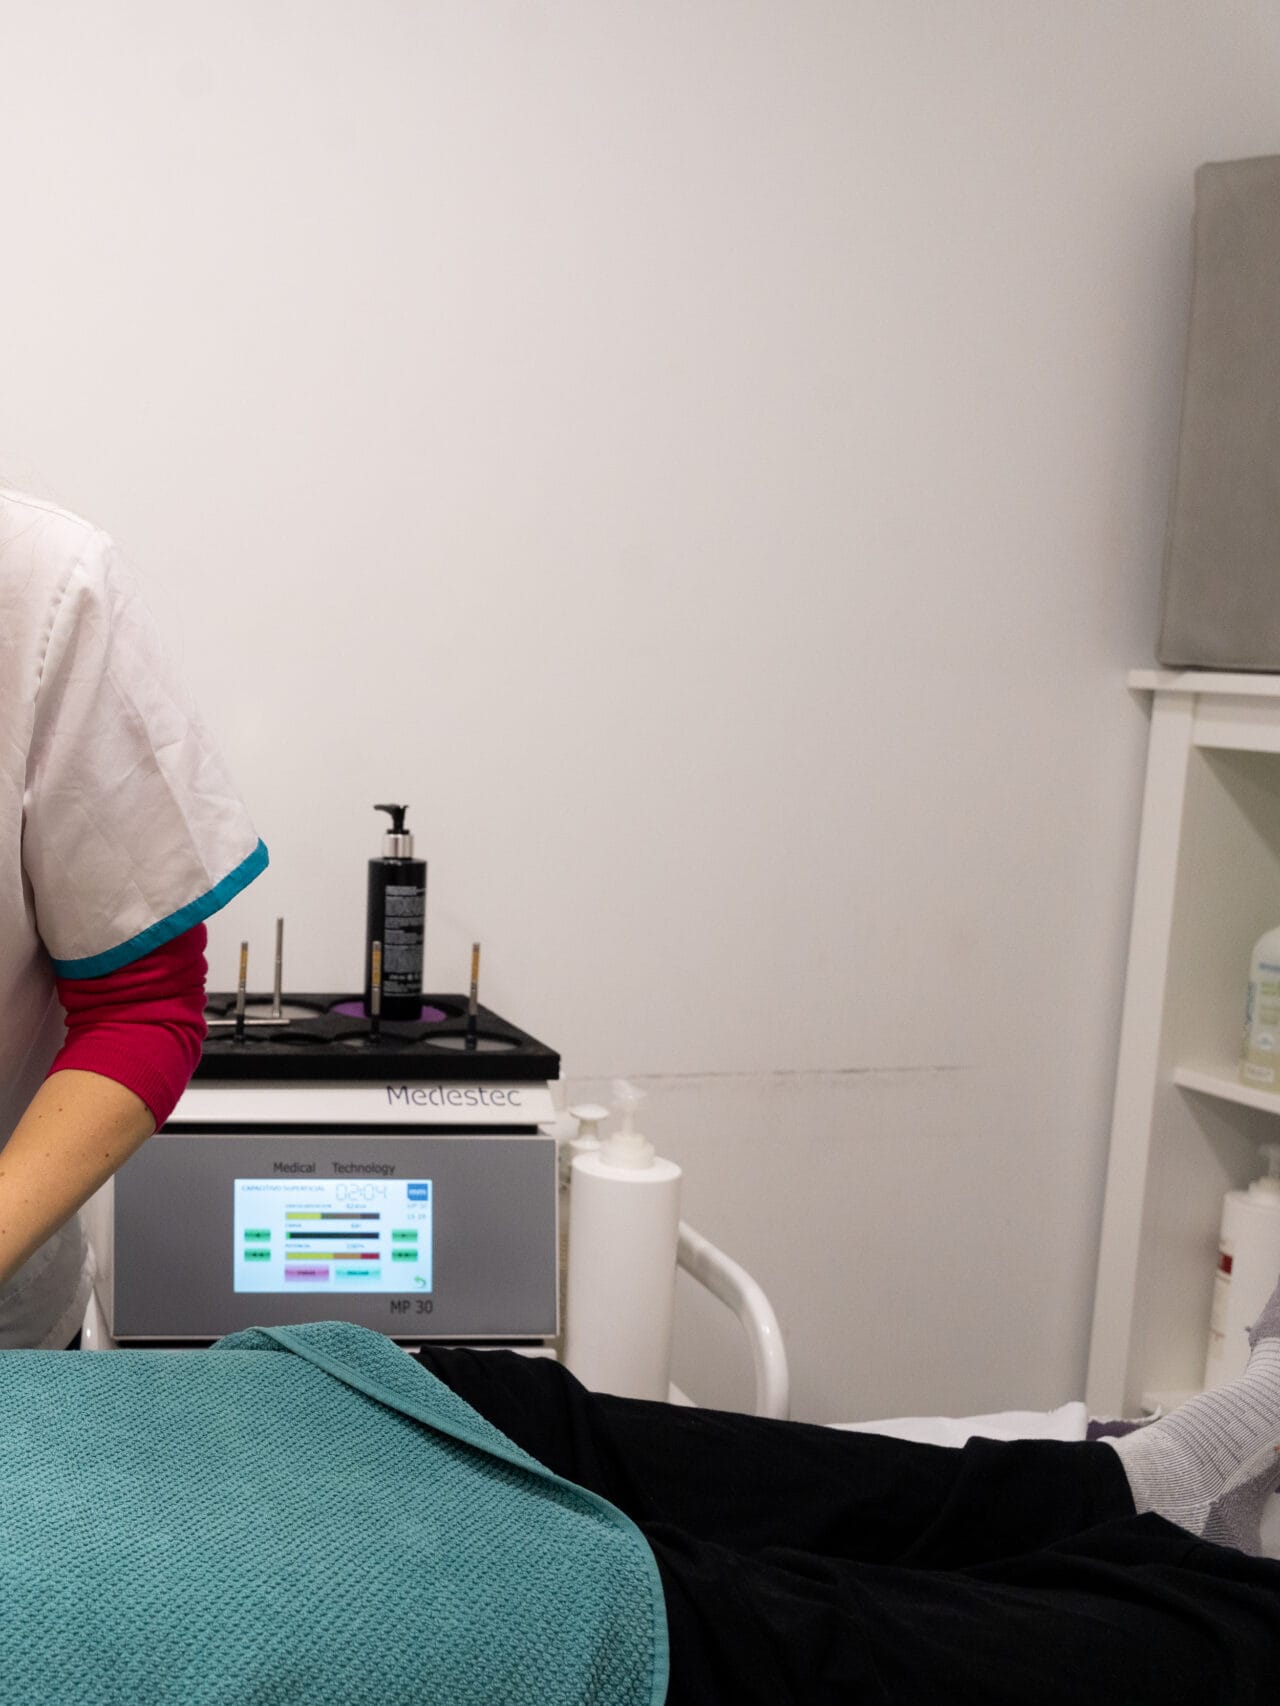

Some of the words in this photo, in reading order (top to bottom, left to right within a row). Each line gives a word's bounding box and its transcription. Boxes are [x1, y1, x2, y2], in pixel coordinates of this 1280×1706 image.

[386, 1085, 522, 1106] Medestec
[273, 1162, 316, 1174] Medical
[332, 1162, 396, 1176] Technology
[390, 1300, 411, 1314] MP
[416, 1300, 434, 1314] 30
